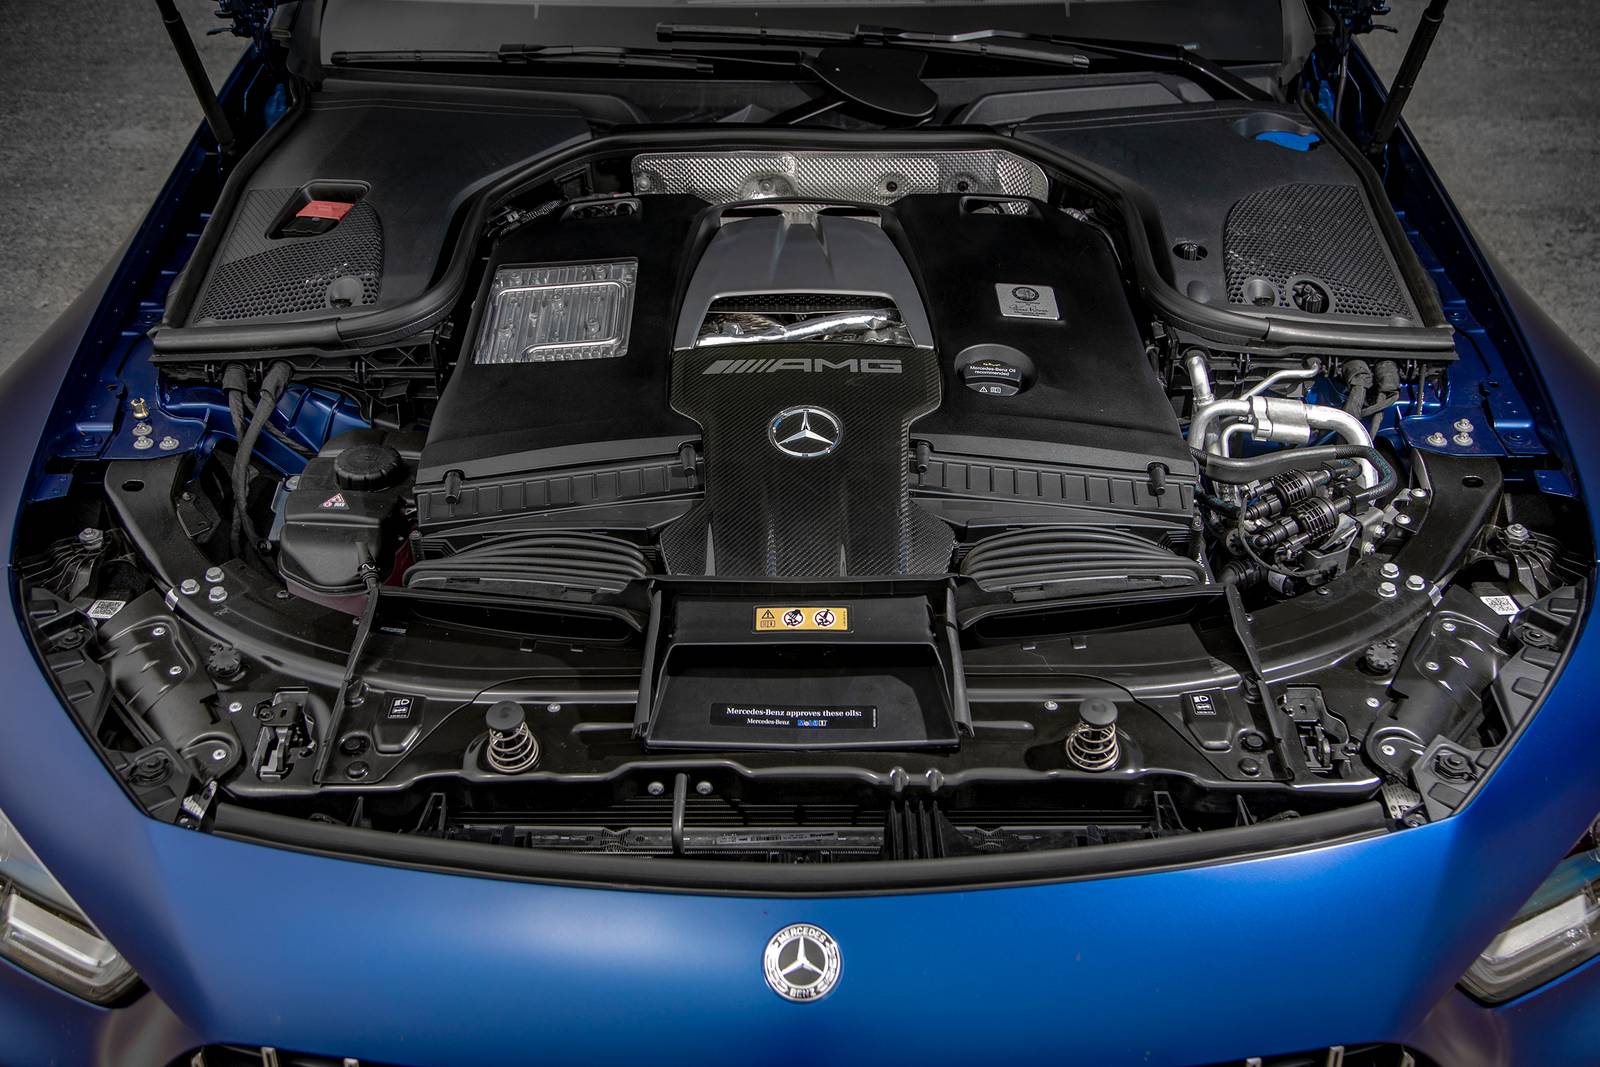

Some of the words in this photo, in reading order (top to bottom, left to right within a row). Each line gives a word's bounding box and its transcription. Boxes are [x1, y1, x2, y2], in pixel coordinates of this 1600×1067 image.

[766, 358, 902, 374] AMG
[969, 365, 1008, 373] Mercedes-Benz
[726, 707, 785, 716] Mercedes-Benz
[786, 710, 821, 718] approves
[822, 709, 844, 717] these
[845, 709, 862, 717] oils:
[746, 718, 790, 726] Mercedes-Benz
[777, 926, 827, 943] MERCEDES
[789, 987, 817, 998] BENZ
